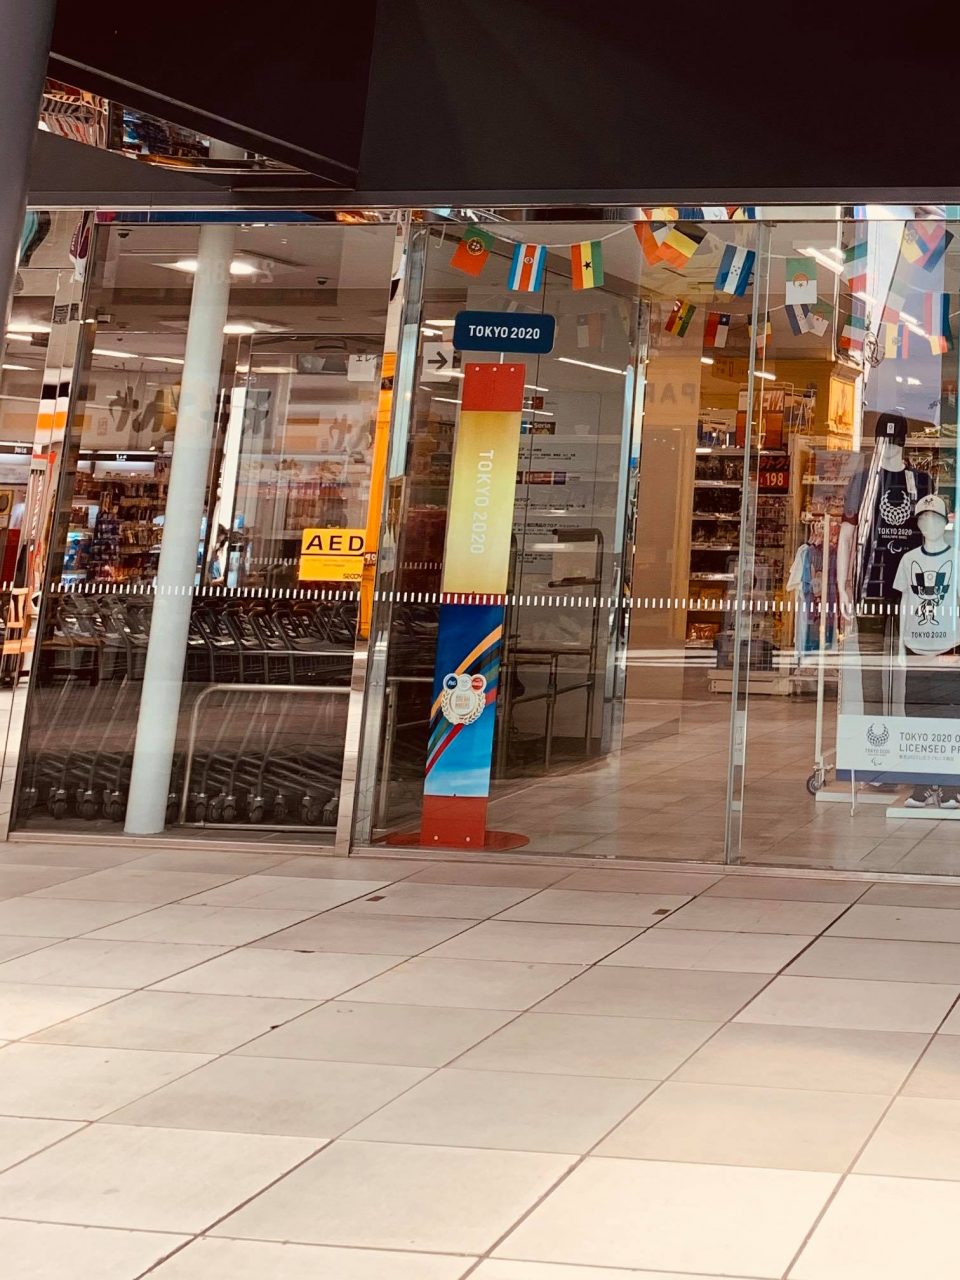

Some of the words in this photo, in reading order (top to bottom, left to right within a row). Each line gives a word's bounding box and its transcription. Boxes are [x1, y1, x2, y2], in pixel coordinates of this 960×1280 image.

[468, 325, 509, 338] TOKYO
[510, 327, 541, 340] 2020
[474, 449, 494, 507] TOKYO
[470, 511, 488, 555] 2020
[878, 527, 897, 535] TOKYO
[897, 528, 913, 536] 2020
[305, 534, 364, 552] AED
[911, 631, 930, 639] TOKYO
[931, 631, 947, 639] 2020
[899, 732, 929, 742] TOKYO
[931, 733, 952, 743] 2020
[899, 743, 947, 754] LICENSED
